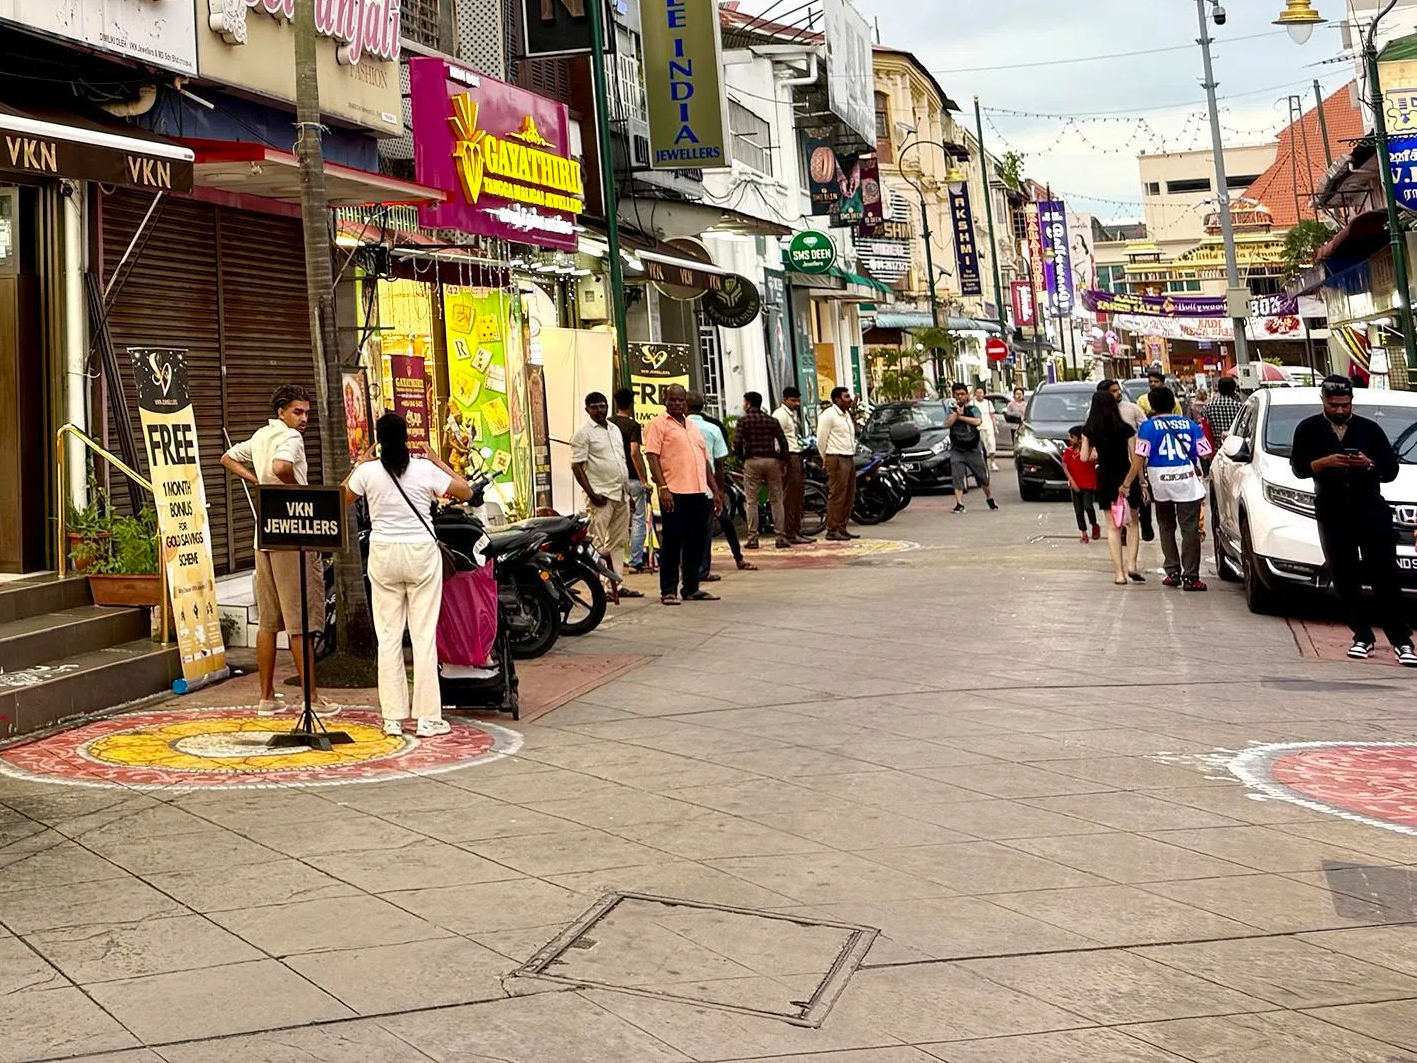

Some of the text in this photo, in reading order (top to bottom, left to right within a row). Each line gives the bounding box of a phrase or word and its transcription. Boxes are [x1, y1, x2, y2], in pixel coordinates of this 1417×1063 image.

[669, 38, 699, 144] INDIA
[6, 135, 58, 173] VKN
[656, 145, 720, 163] JEWELLERS
[128, 155, 172, 190] VKN
[793, 248, 831, 260] SMS DEEN
[147, 424, 196, 467] FREE
[168, 480, 192, 497] MONTH
[170, 501, 193, 518] BONUS
[285, 501, 314, 517] VKN
[178, 522, 188, 531] FOR
[264, 518, 339, 536] JEWELLERS
[166, 531, 204, 548] GOLD SAVINGS
[179, 551, 199, 567] SCHEME
